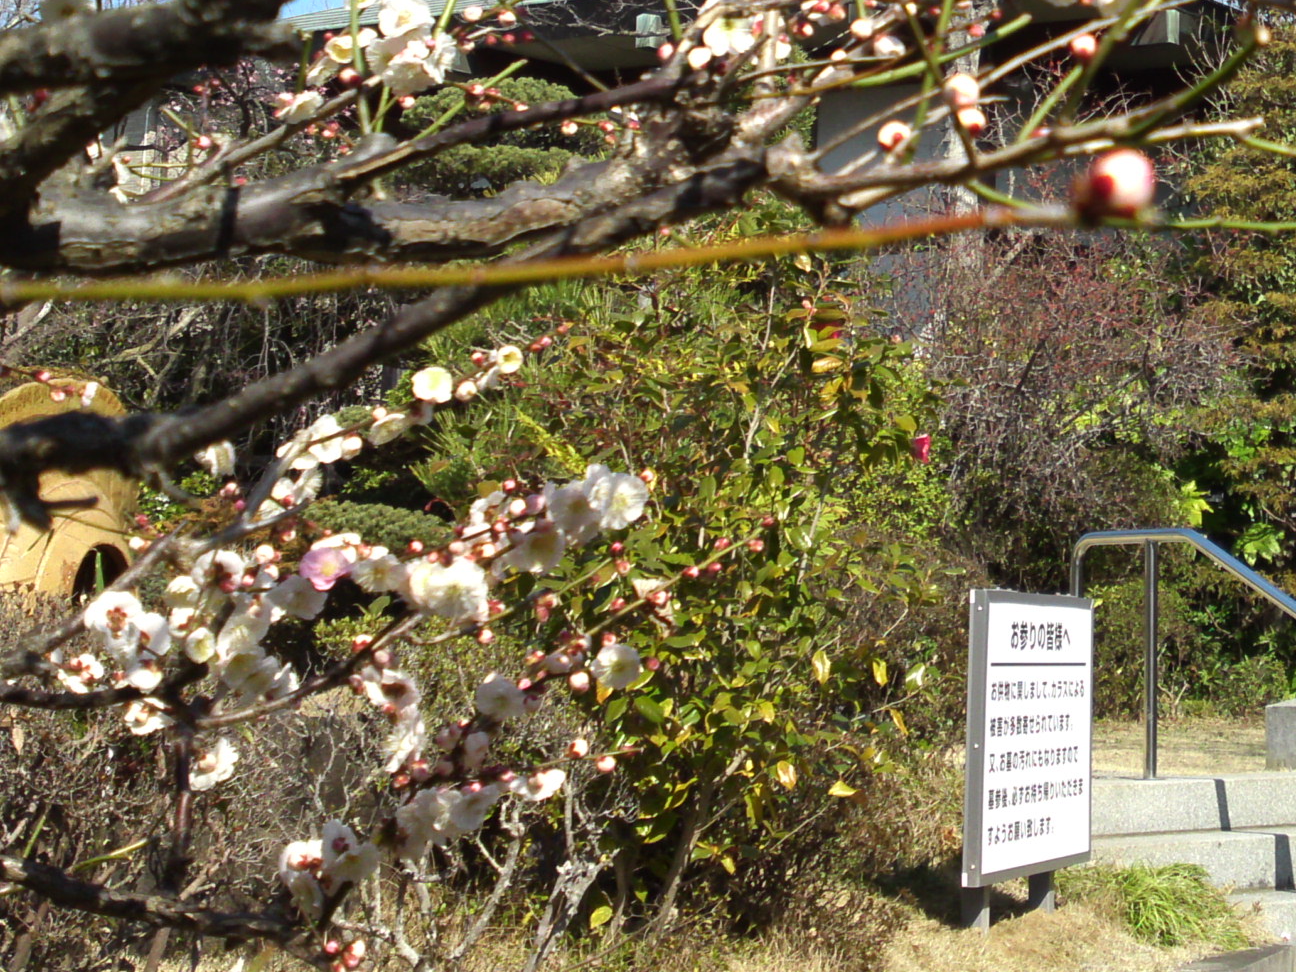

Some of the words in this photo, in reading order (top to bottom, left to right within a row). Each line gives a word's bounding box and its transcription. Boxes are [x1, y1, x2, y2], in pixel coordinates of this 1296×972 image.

[1011, 621, 1071, 651] お参りの皆様へ
